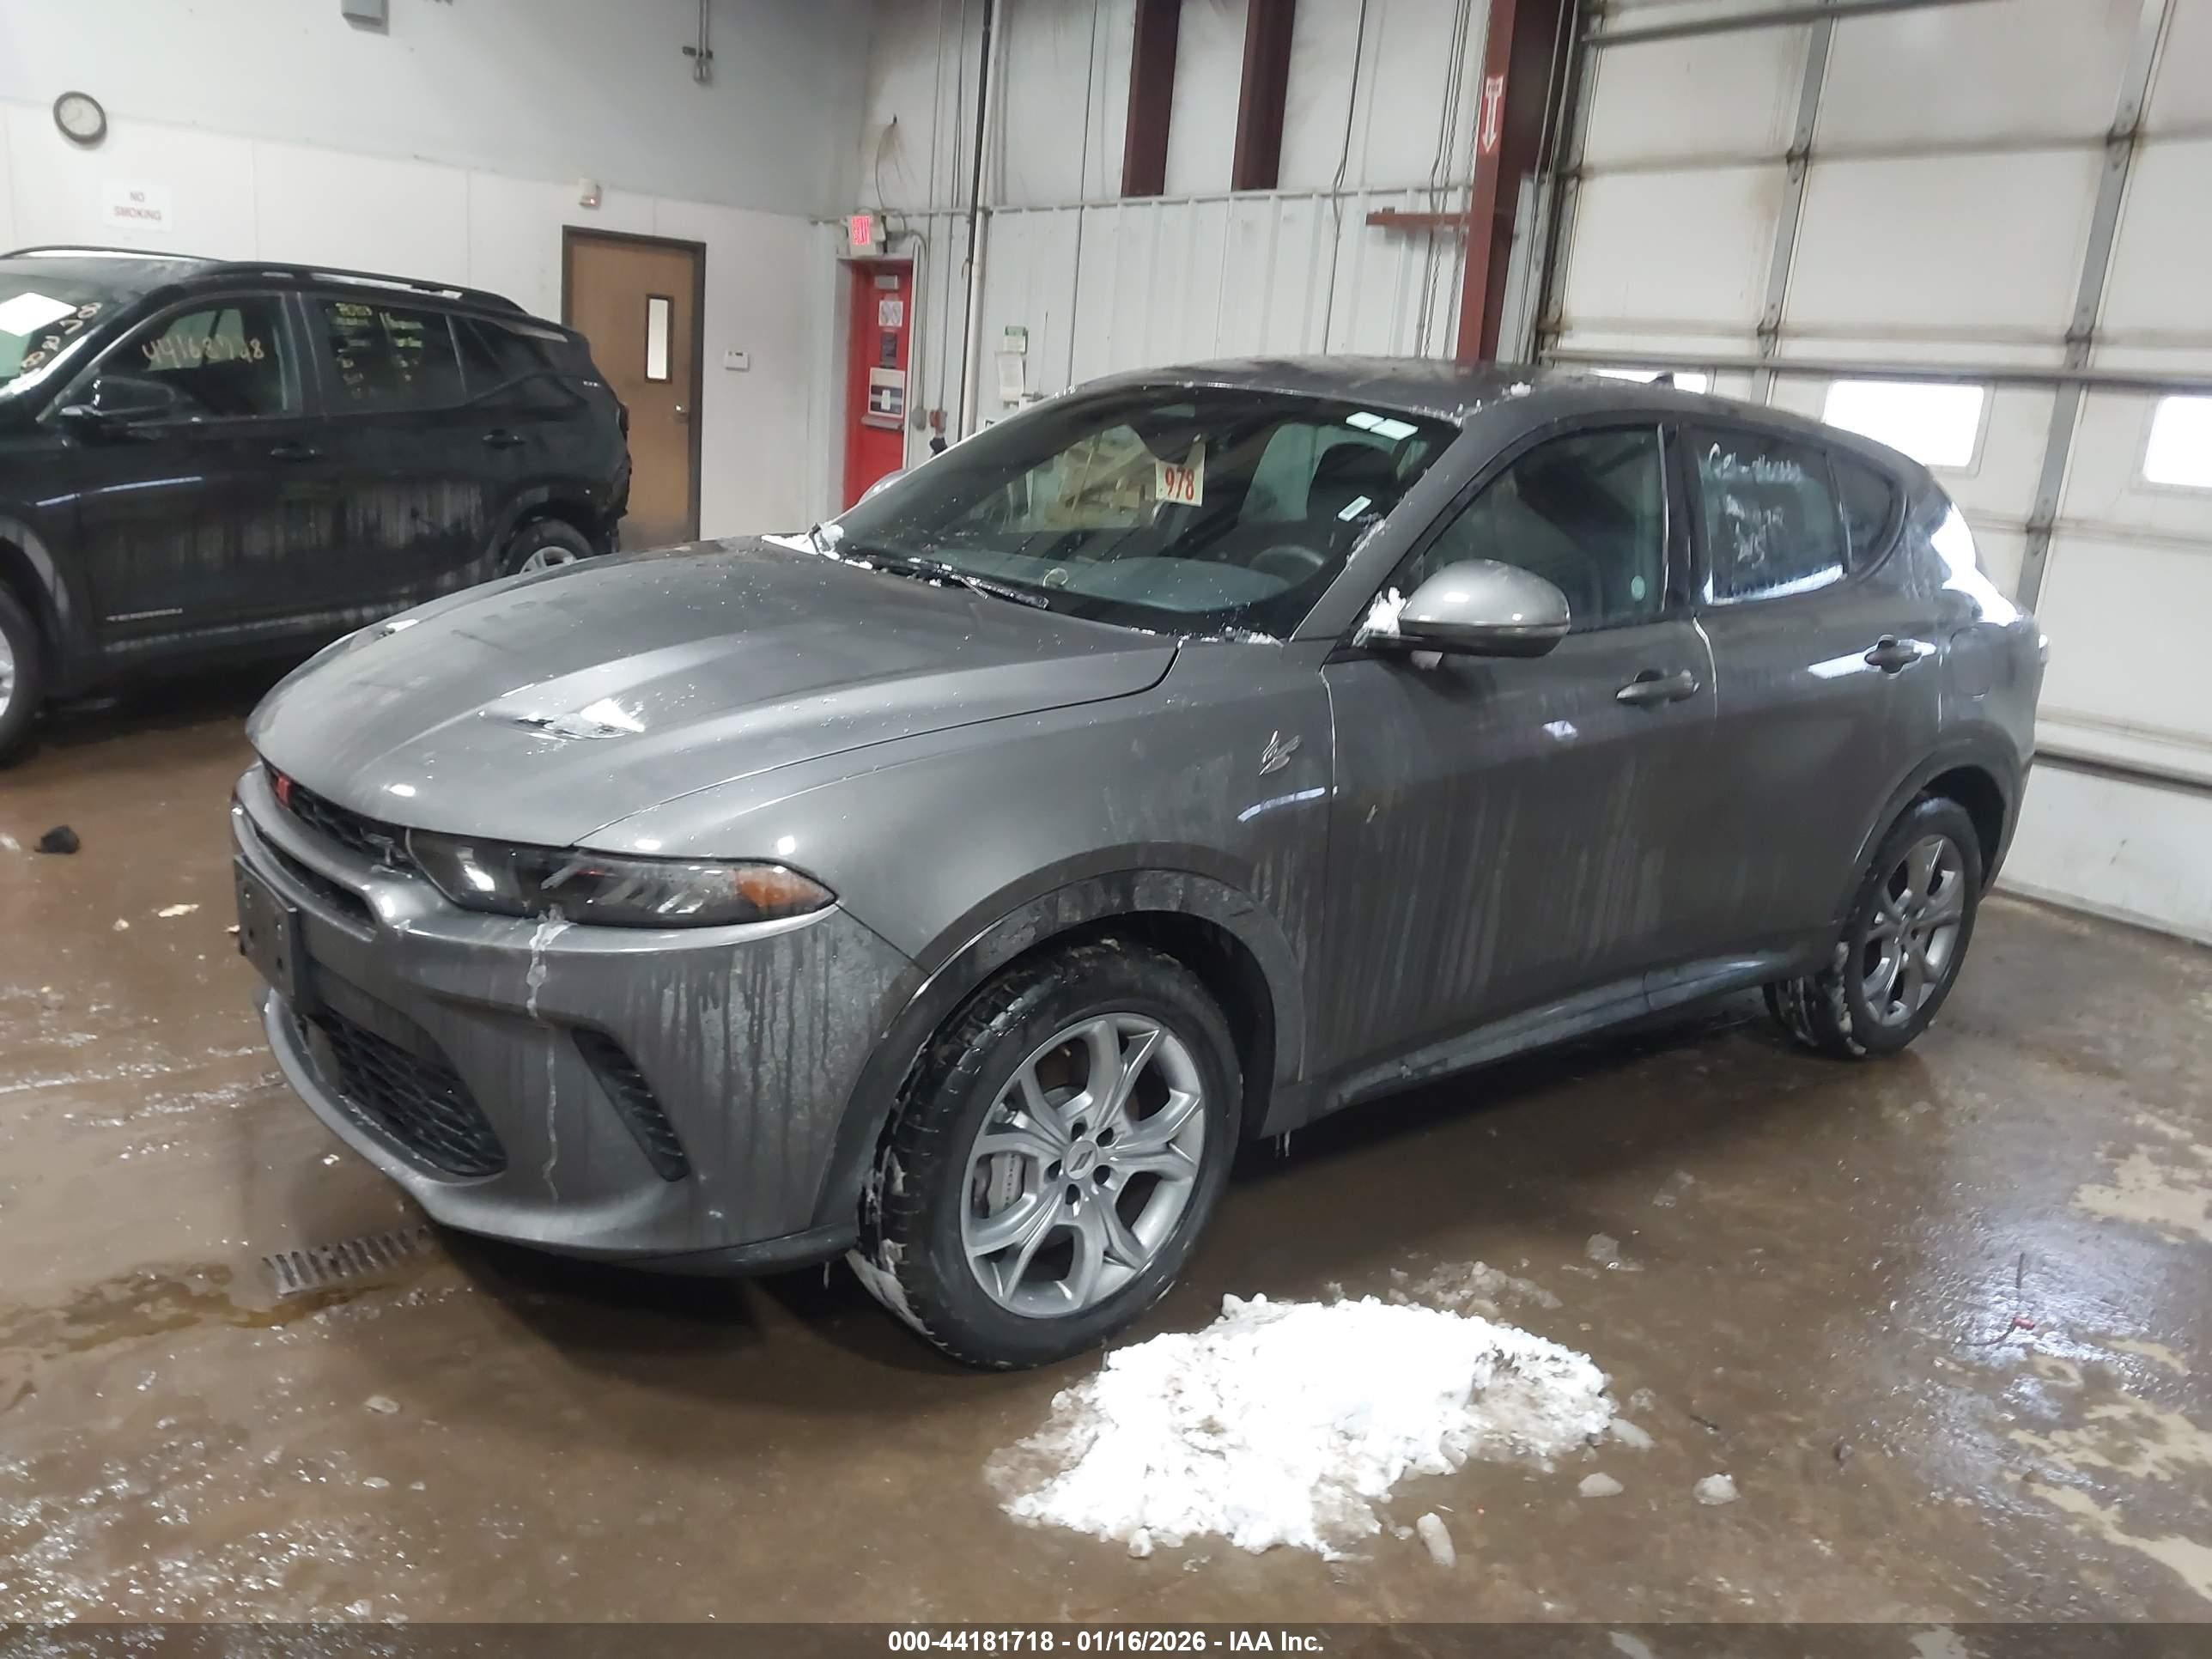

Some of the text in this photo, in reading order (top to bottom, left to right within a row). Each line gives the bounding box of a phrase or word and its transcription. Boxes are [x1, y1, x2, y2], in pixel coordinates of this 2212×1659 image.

[130, 191, 144, 203] NO
[113, 205, 161, 221] SMOKING
[1164, 466, 1195, 501] 978
